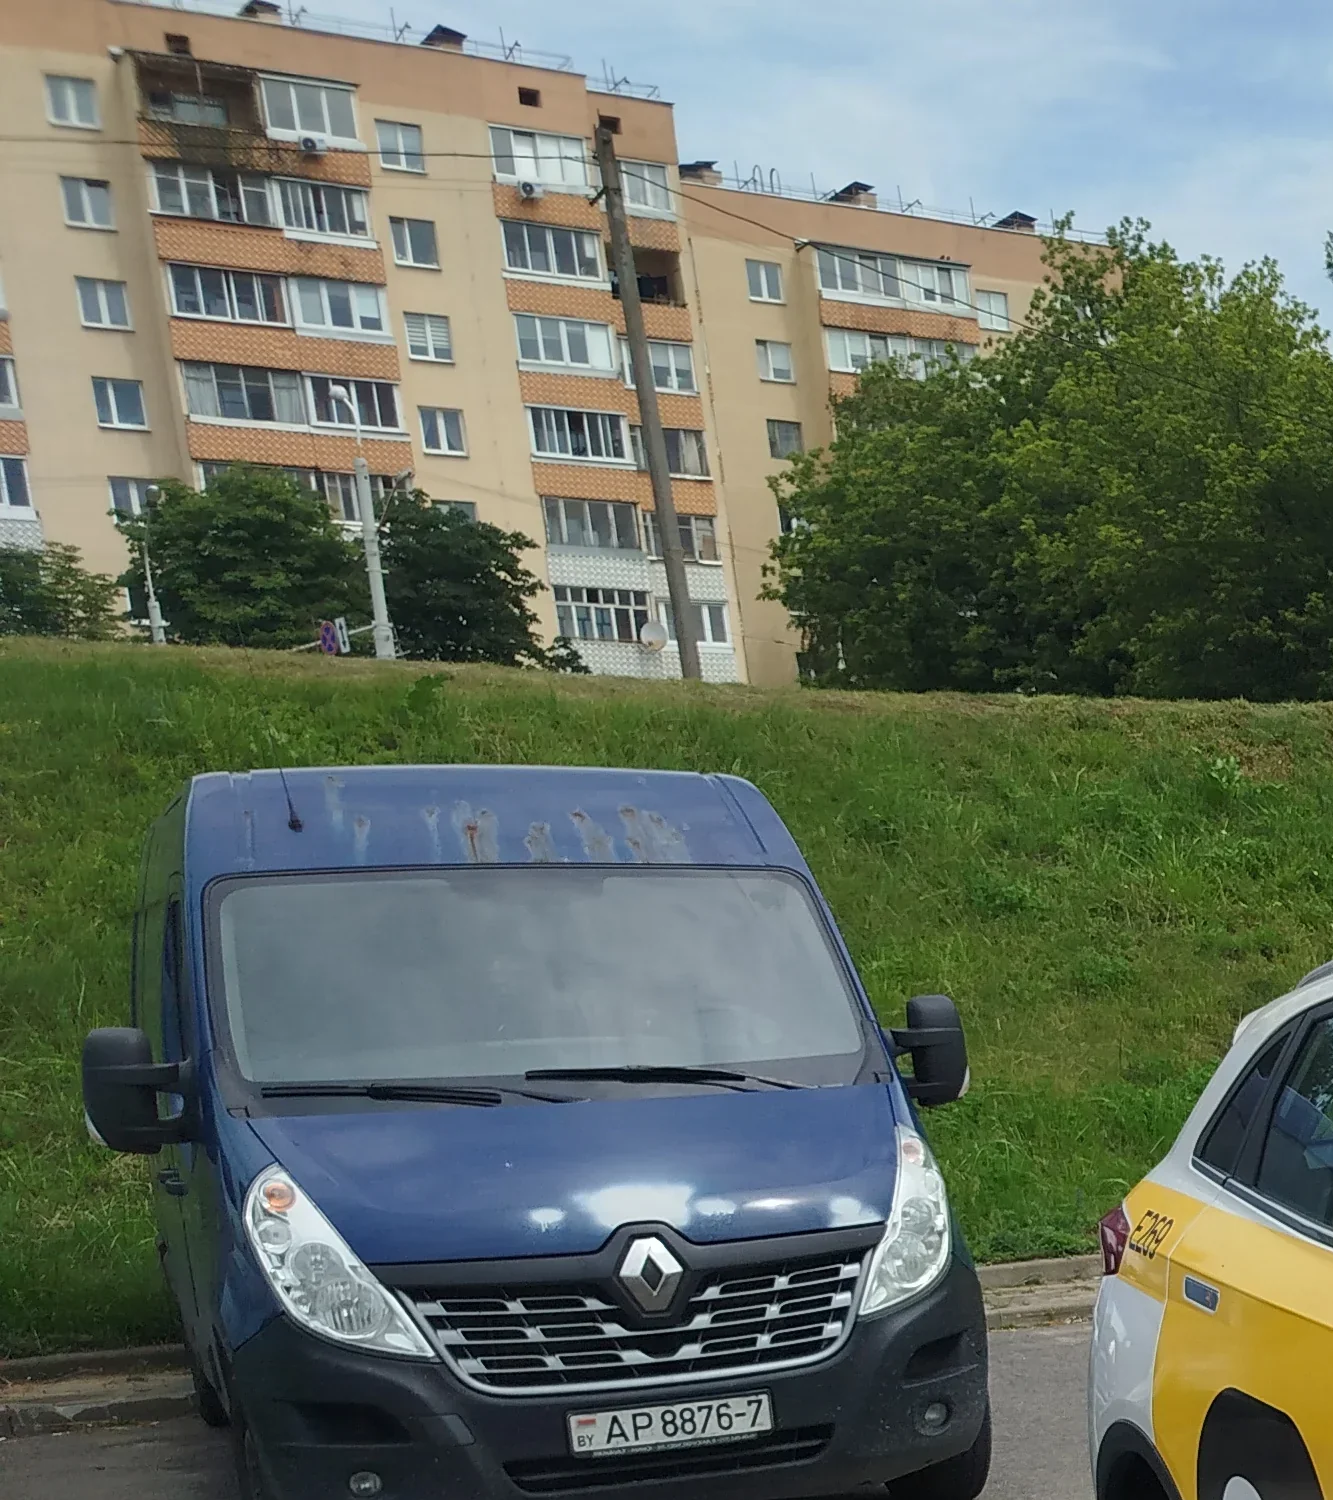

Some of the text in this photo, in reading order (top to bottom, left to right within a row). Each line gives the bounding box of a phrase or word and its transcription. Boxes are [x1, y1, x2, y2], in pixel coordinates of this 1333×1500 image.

[1129, 1209, 1174, 1260] E269
[577, 1434, 595, 1448] BY
[606, 1412, 654, 1445] AP
[660, 1399, 764, 1438] 8876-7
